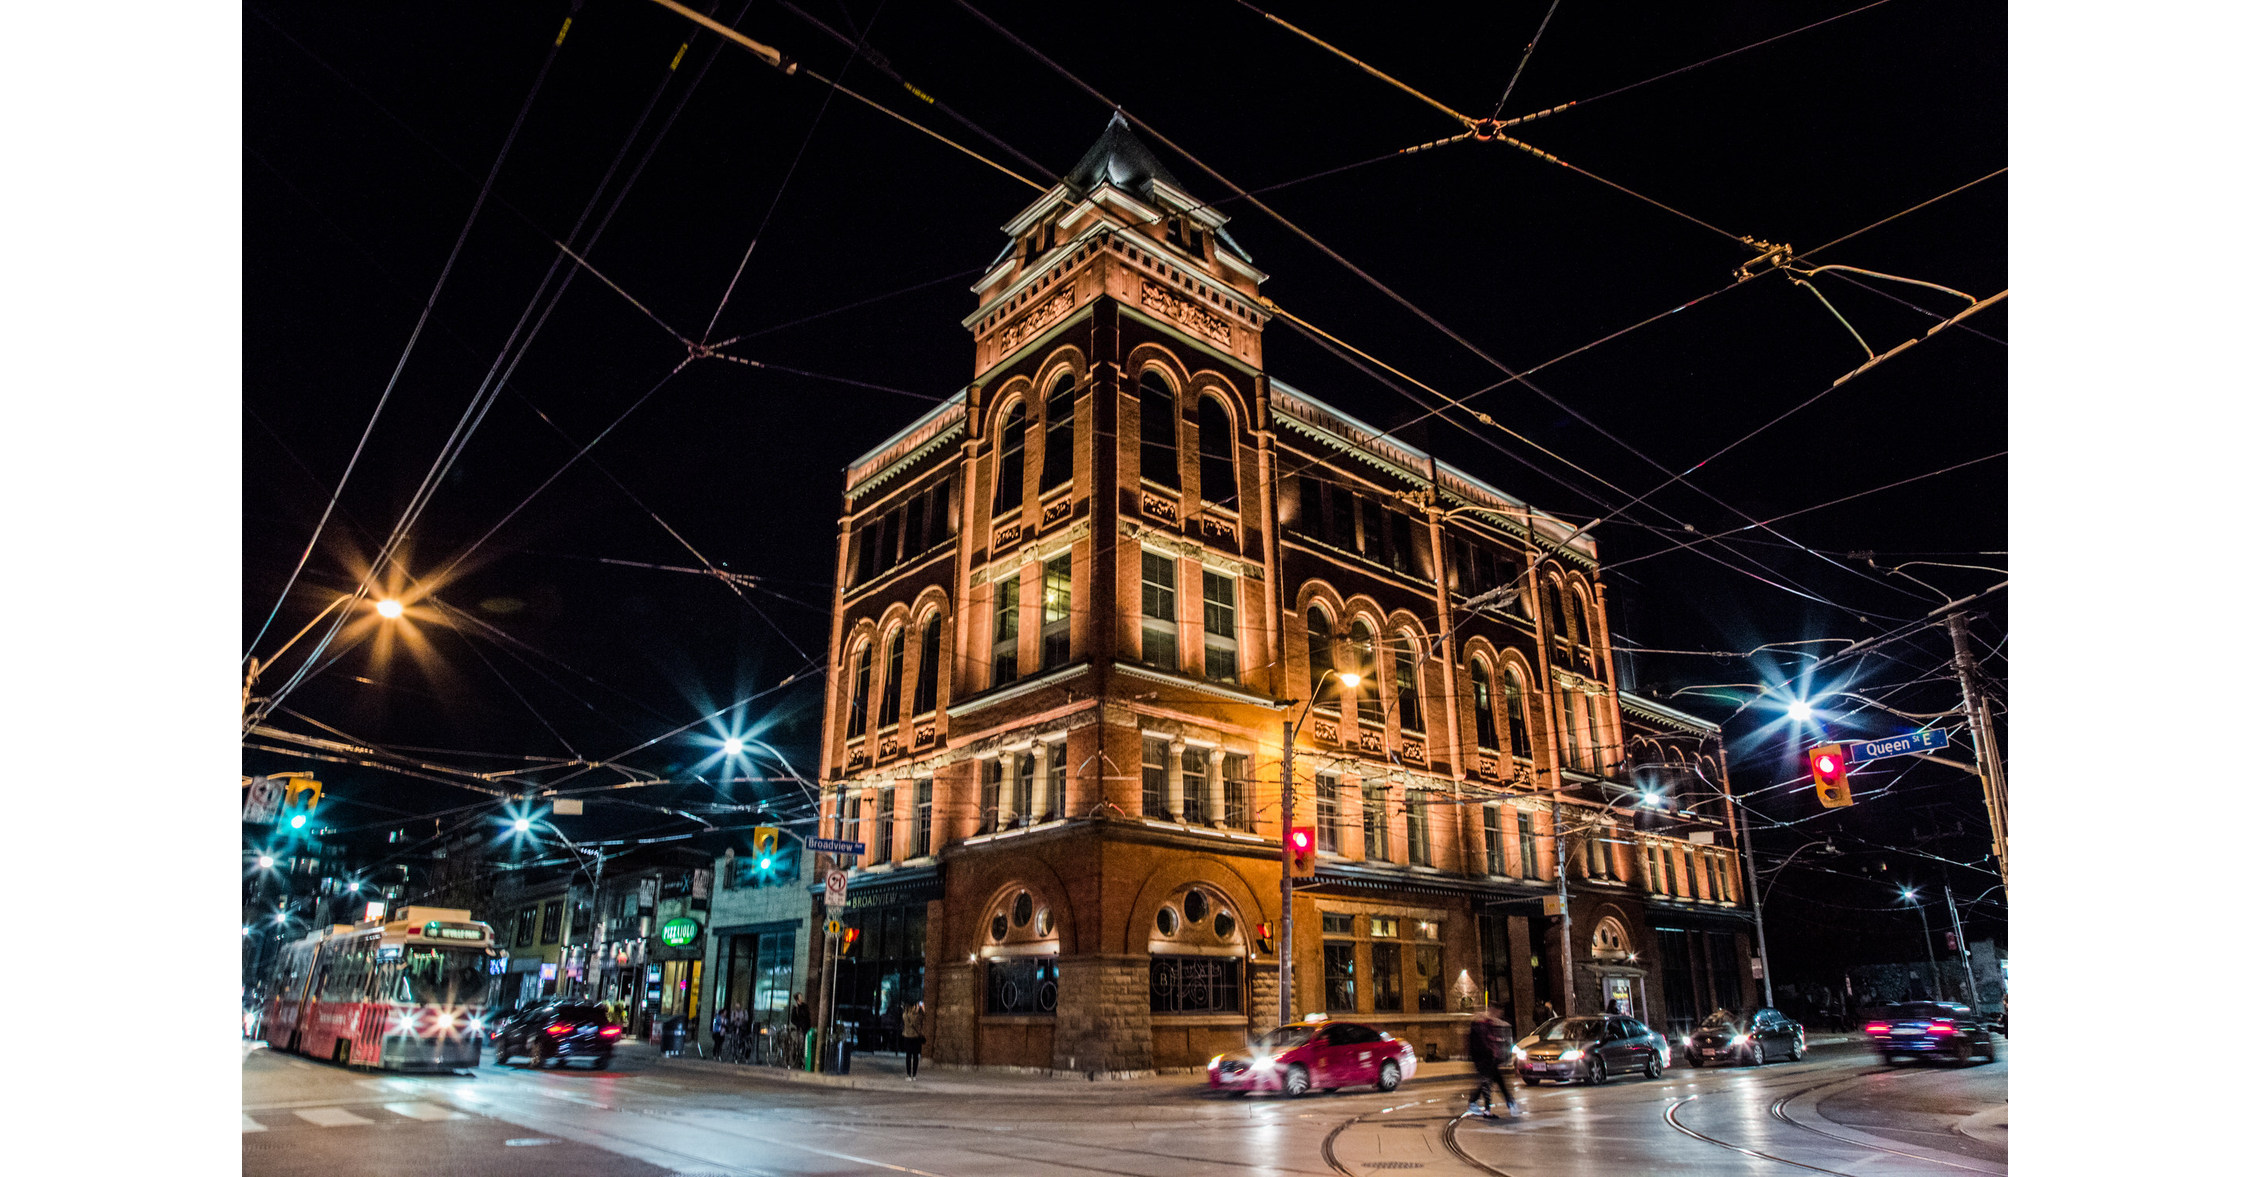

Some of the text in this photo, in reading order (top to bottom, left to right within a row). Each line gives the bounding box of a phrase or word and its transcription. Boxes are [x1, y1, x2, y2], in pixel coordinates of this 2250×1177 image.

[1866, 733, 1932, 757] Queen St E
[808, 837, 853, 852] Broadview
[852, 891, 897, 909] BROADVIEW
